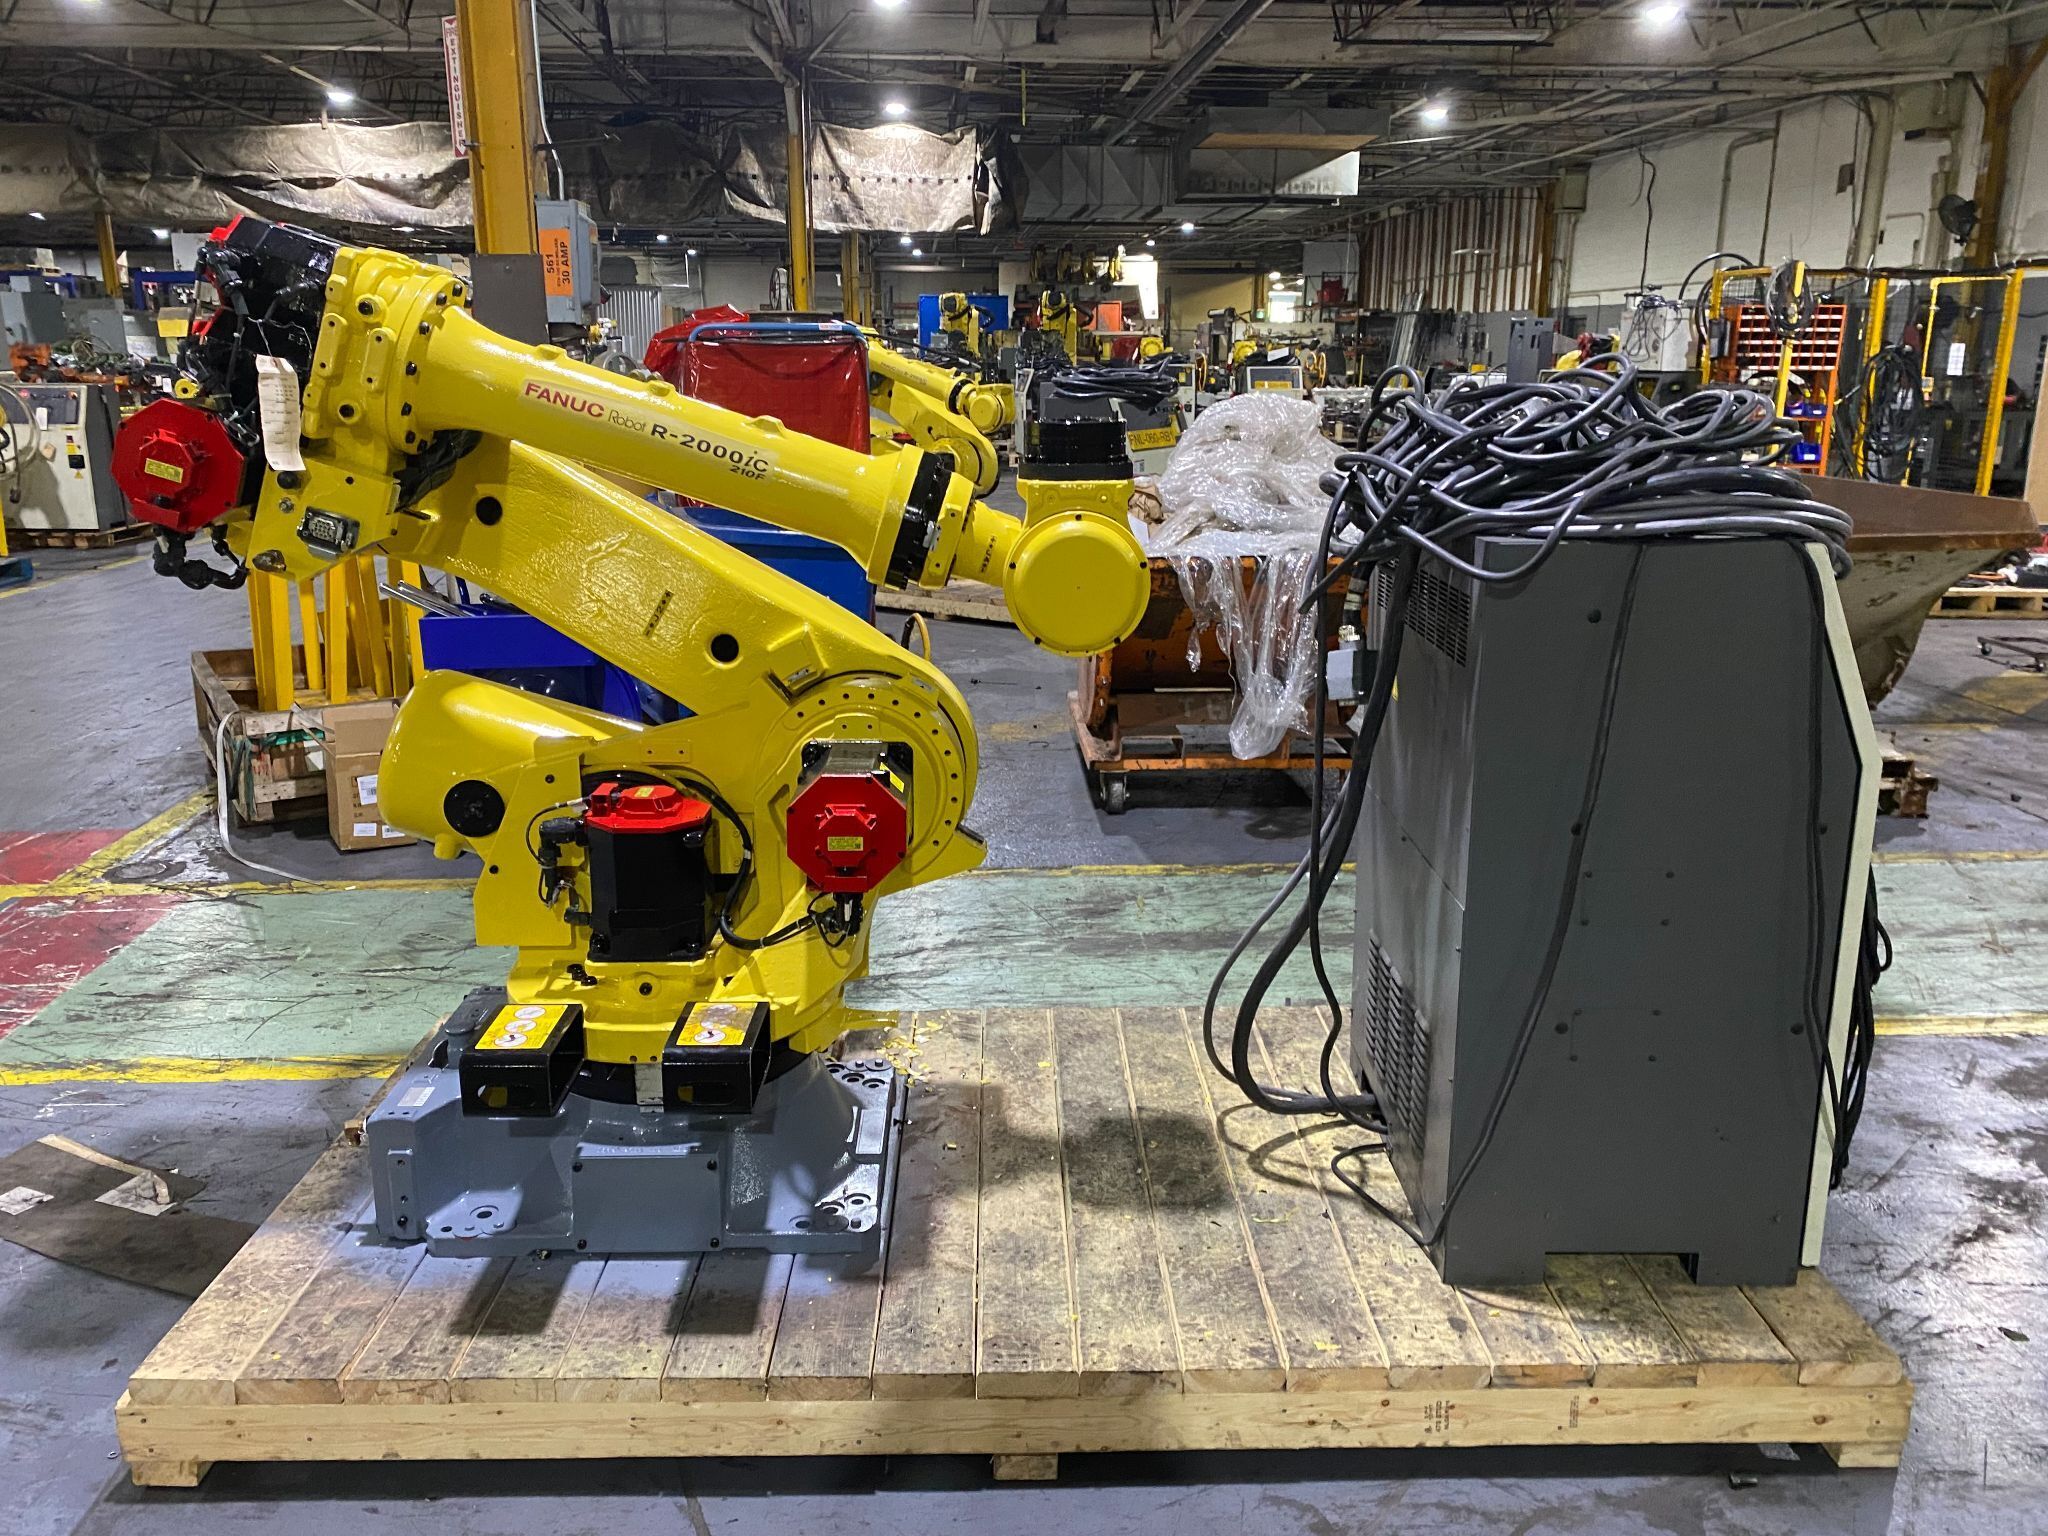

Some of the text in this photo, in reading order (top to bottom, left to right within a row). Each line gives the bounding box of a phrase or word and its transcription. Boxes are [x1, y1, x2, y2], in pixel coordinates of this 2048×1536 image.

[545, 254, 555, 274] 561
[559, 241, 571, 285] 30 AMP
[524, 382, 605, 418] FANUC
[607, 409, 647, 433] Robot
